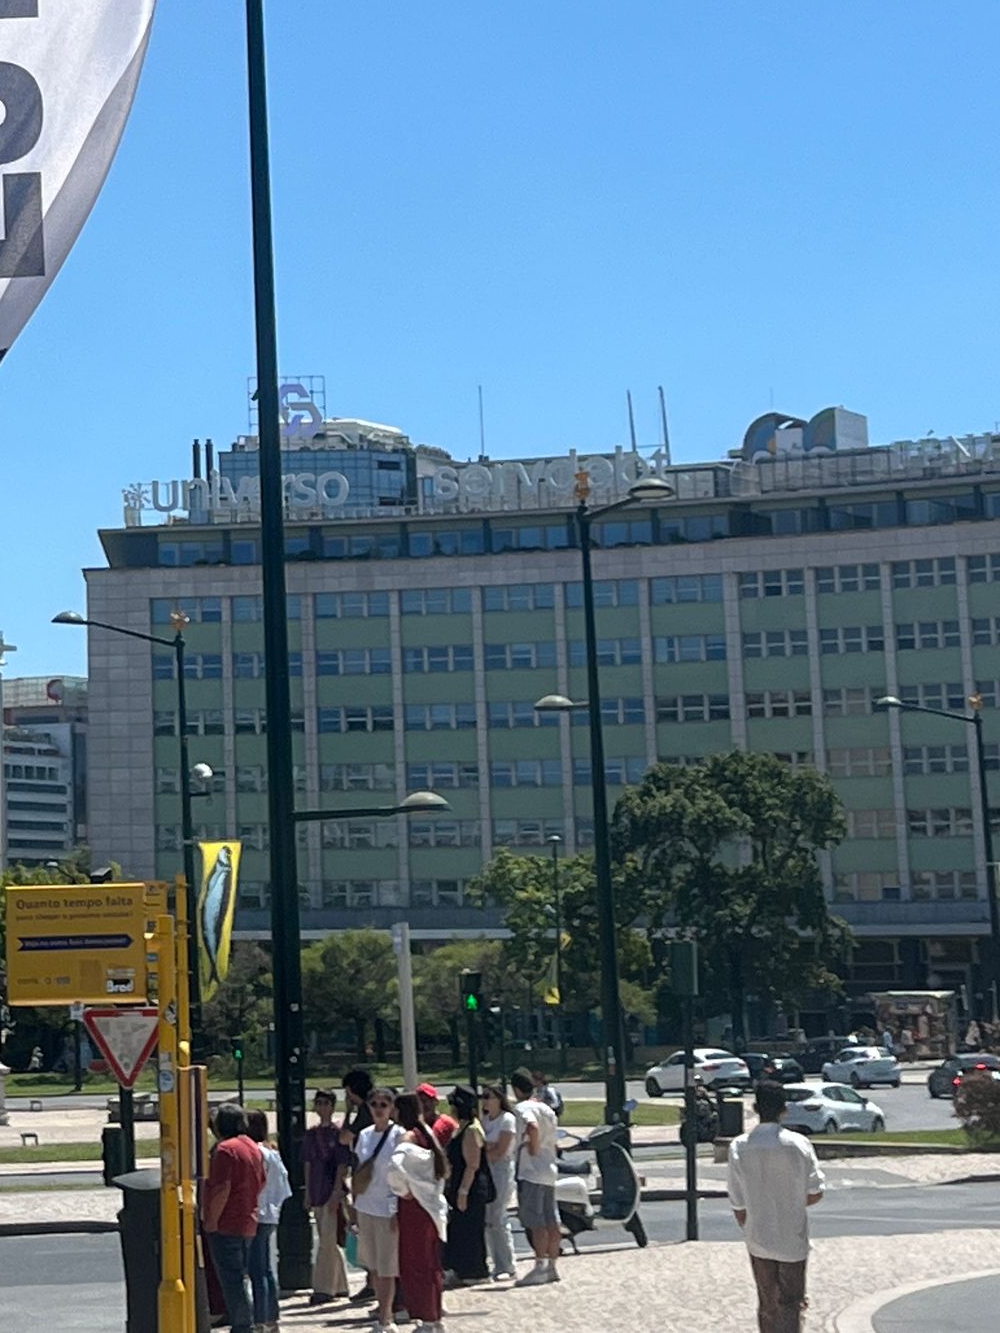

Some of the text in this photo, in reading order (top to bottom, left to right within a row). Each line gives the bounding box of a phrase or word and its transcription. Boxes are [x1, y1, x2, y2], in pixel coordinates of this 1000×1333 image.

[16, 895, 133, 910] Quanto tempo falta
